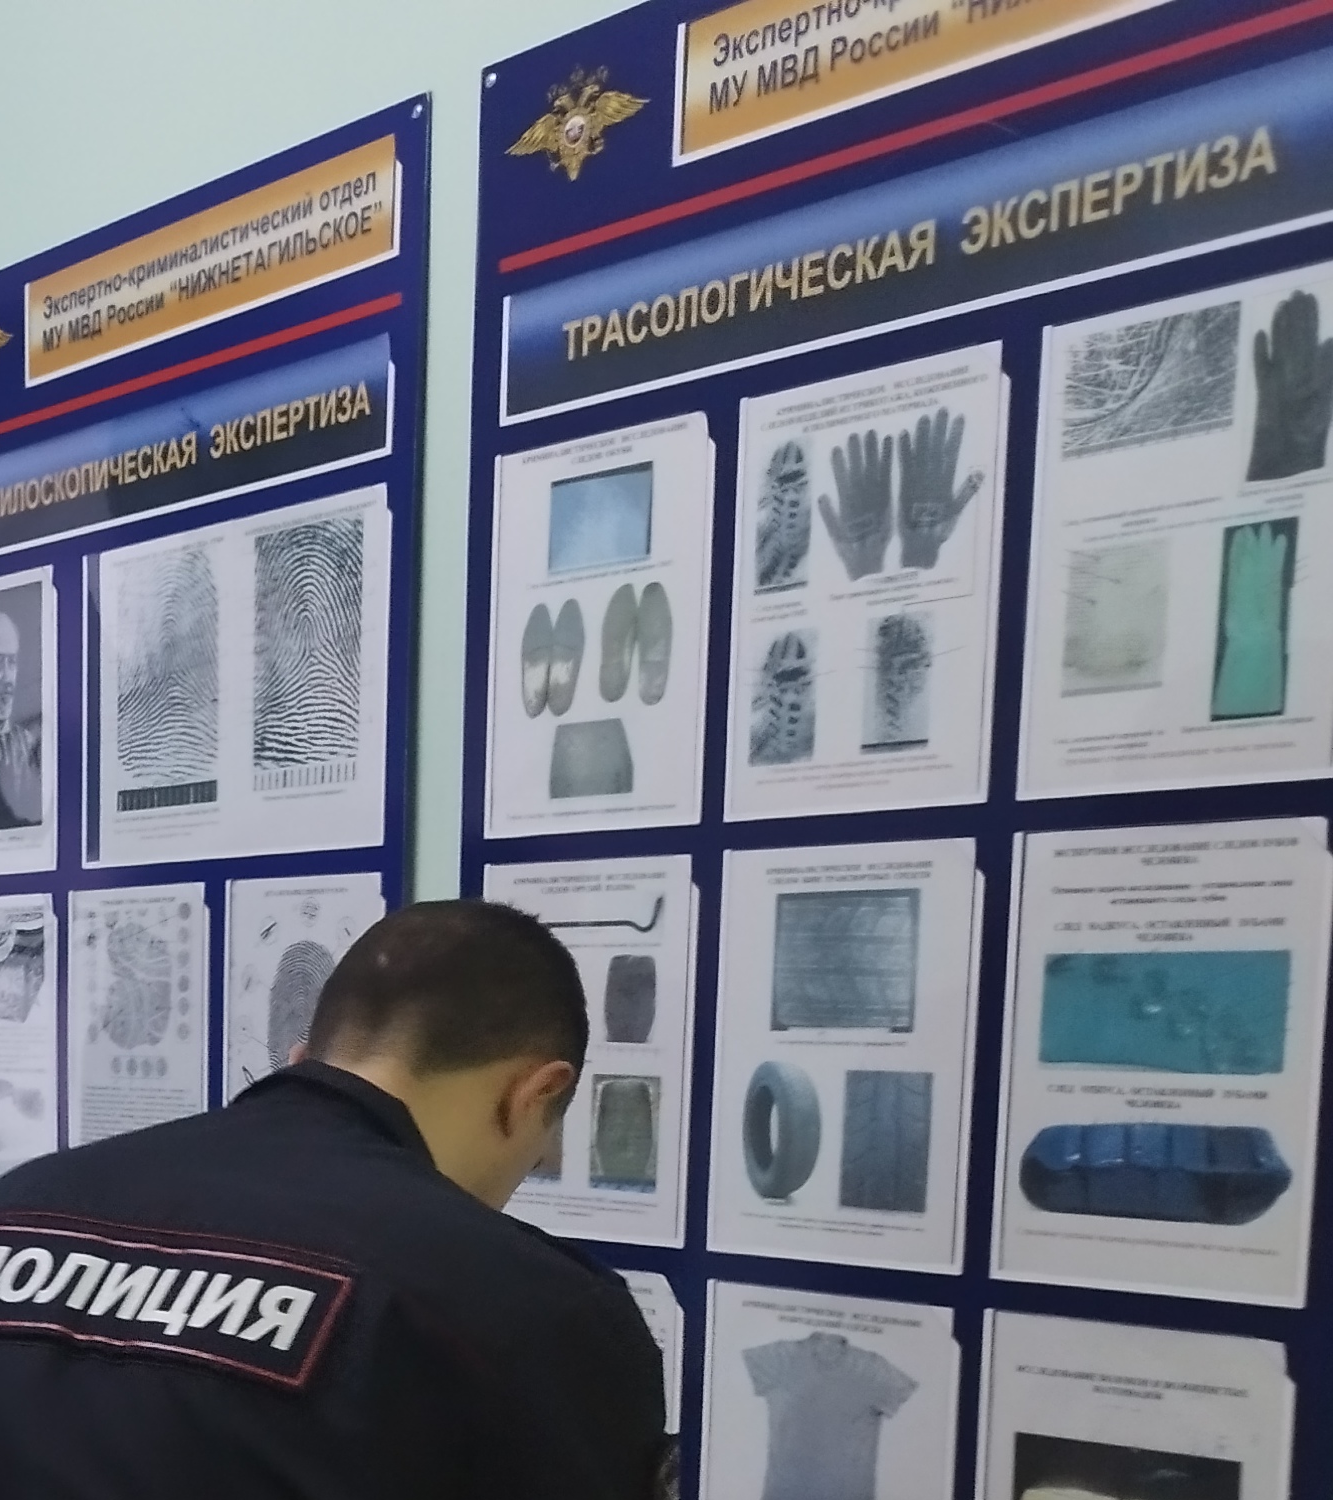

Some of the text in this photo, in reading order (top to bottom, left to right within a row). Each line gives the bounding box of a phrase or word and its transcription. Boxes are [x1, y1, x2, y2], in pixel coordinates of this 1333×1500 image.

[708, 74, 748, 115] МУ
[756, 45, 820, 98] МВД
[830, 10, 940, 72] России
[42, 171, 377, 320] Экспертно-криминалистический отдел
[563, 126, 1277, 360] ТРАСОЛОГИЧЕСКАЯ ЭКСПЕРТИЗА
[41, 323, 65, 353] МУ
[67, 310, 102, 346] МВД
[107, 292, 165, 329] России
[208, 380, 371, 460] ЭКСПЕРТИЗА
